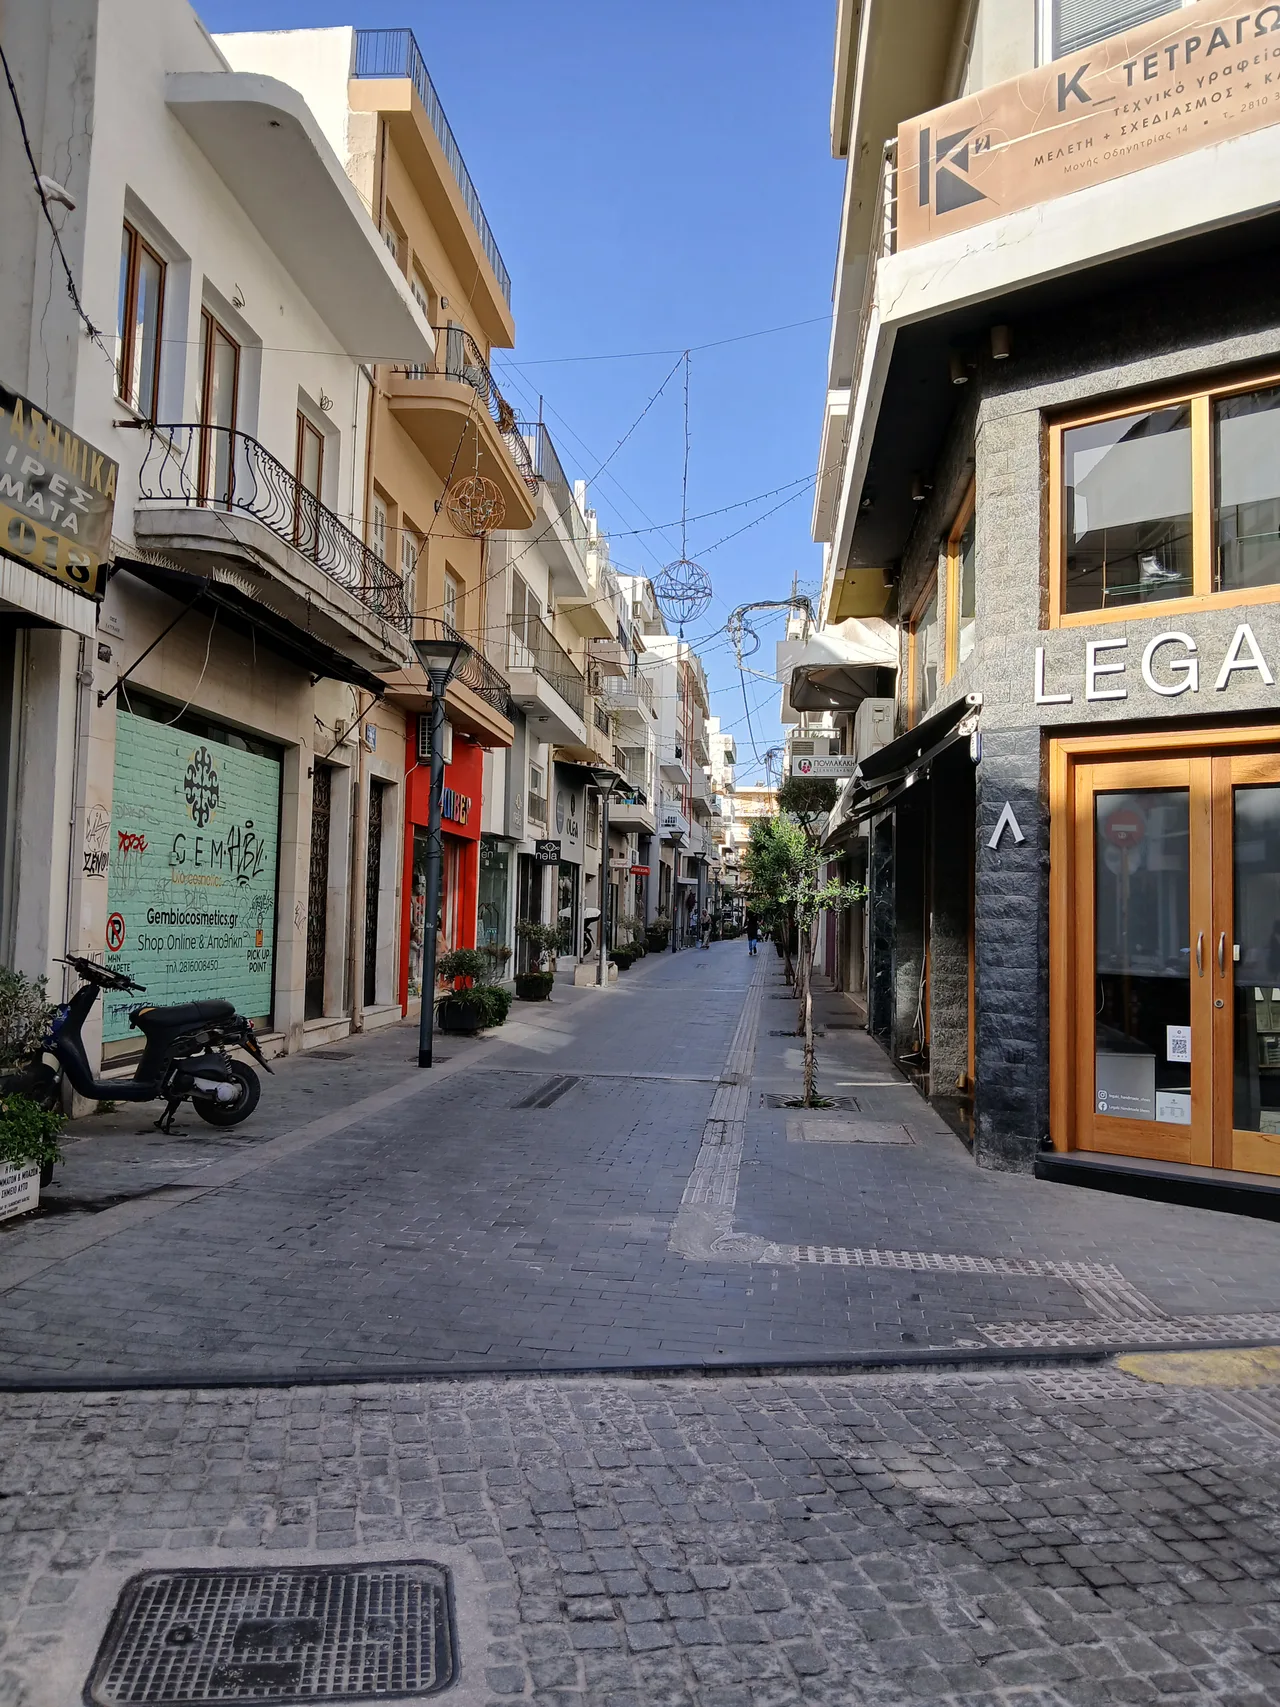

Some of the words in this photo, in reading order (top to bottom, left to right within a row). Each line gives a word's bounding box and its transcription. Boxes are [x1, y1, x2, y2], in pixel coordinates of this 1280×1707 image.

[1033, 138, 1094, 166] ΜΕΛΕΤΗ
[1120, 87, 1233, 136] ΣΧΕΔΙΑΣΜΟΣ
[1113, 81, 1185, 117] τεχνικό
[1063, 155, 1099, 174] Μονής
[1103, 130, 1172, 160] Οδηγητρίας
[1177, 124, 1189, 134] 14
[1240, 96, 1268, 113] 2810
[5, 444, 93, 513] ΙΡΕΣ
[9, 397, 116, 501] ΑΣΗΜΙΚΑ
[0, 473, 79, 535] ΜΑΤΑ
[7, 516, 91, 584] 018
[1034, 623, 1275, 705] LEGA
[137, 934, 164, 953] Shop
[167, 933, 197, 950] Online
[198, 934, 206, 950] &
[146, 907, 239, 929] Gembiocosmetics.gr
[246, 950, 261, 961] PICK
[261, 949, 270, 960] UP
[248, 961, 267, 973] POINT
